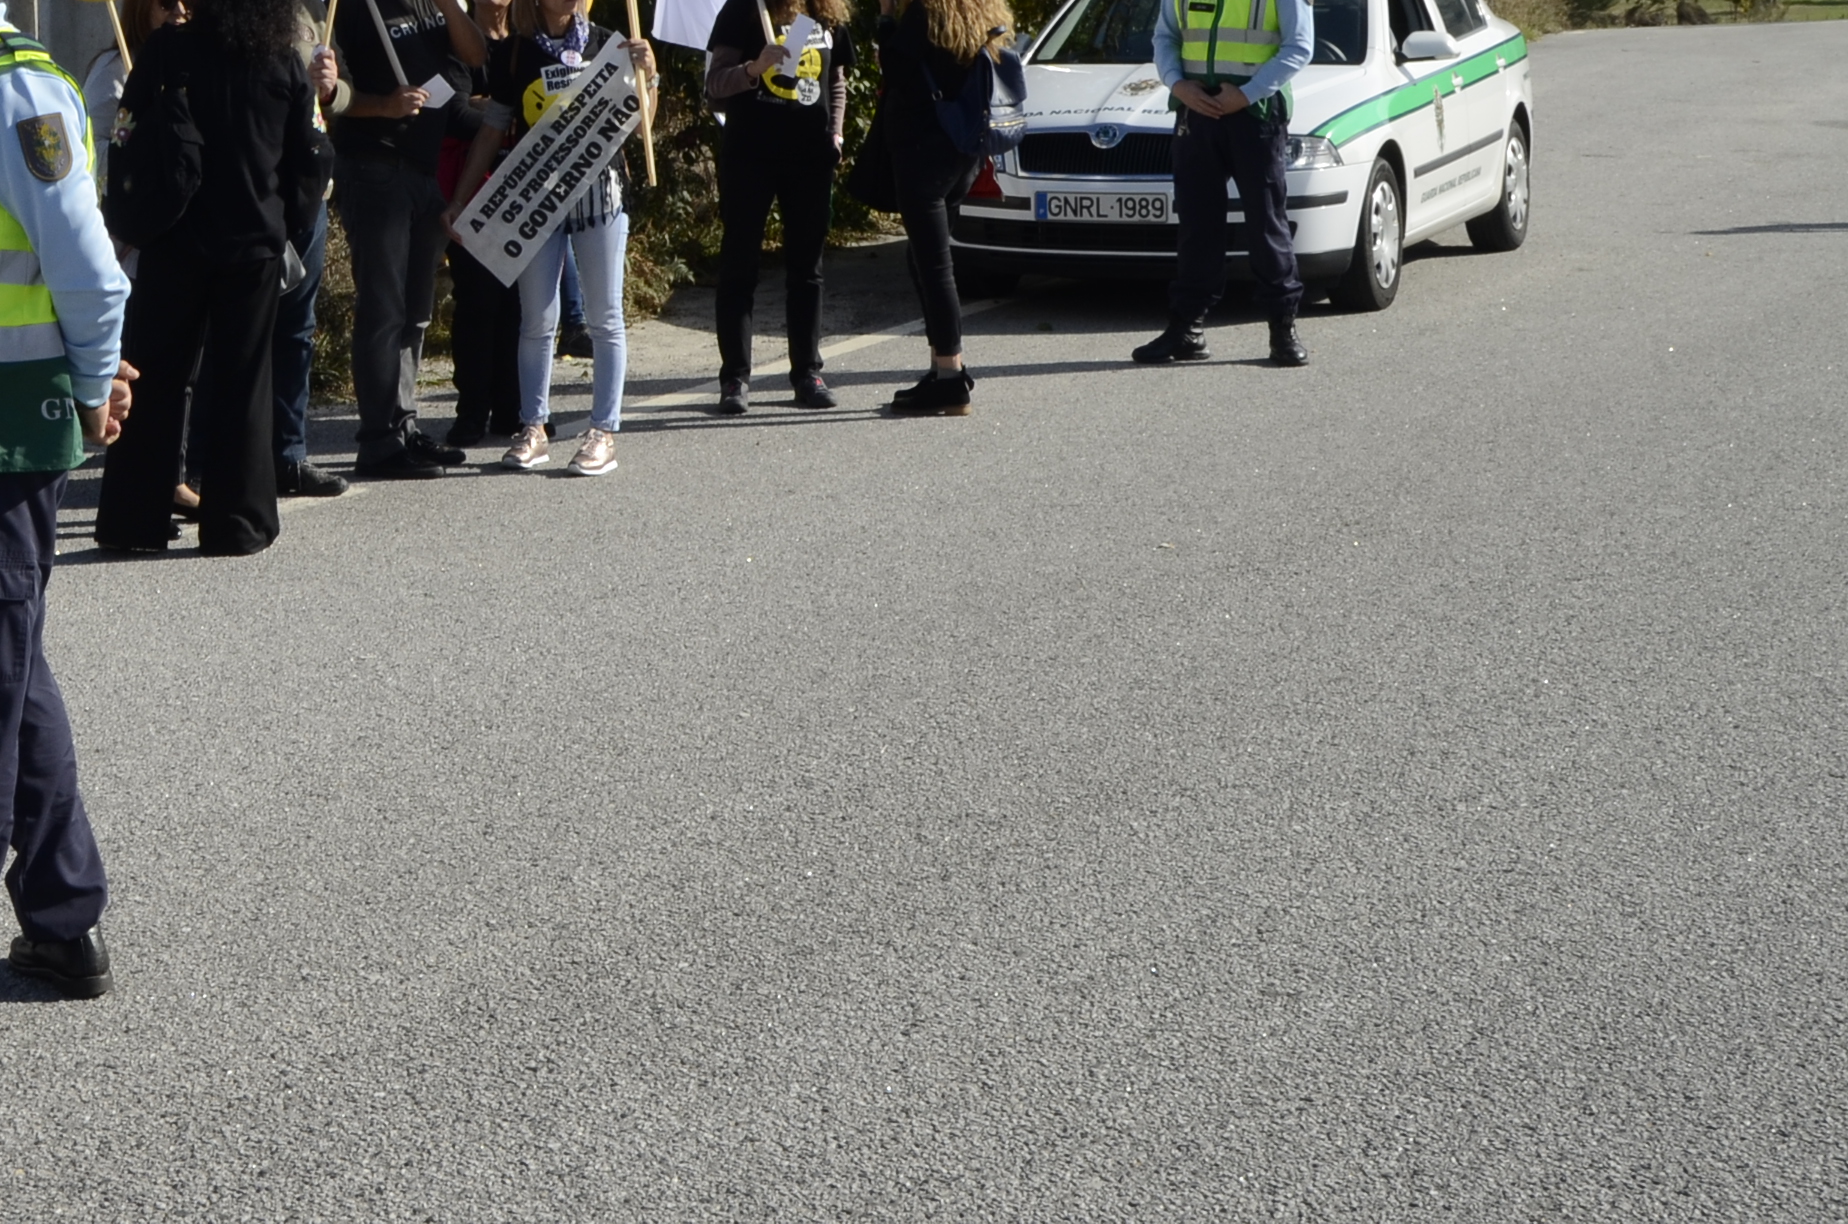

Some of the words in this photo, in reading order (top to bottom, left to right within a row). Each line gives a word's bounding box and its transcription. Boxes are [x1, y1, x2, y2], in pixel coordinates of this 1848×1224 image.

[469, 217, 485, 234] A
[479, 132, 555, 220] REPÚBLICA
[549, 61, 619, 143] RESPEITA
[501, 201, 524, 225] OS
[520, 96, 613, 204] PROFESSORES.
[503, 239, 523, 259] O
[518, 140, 603, 241] GOVERNO
[597, 94, 641, 144] NÃO
[1049, 106, 1135, 116] NACIONAL
